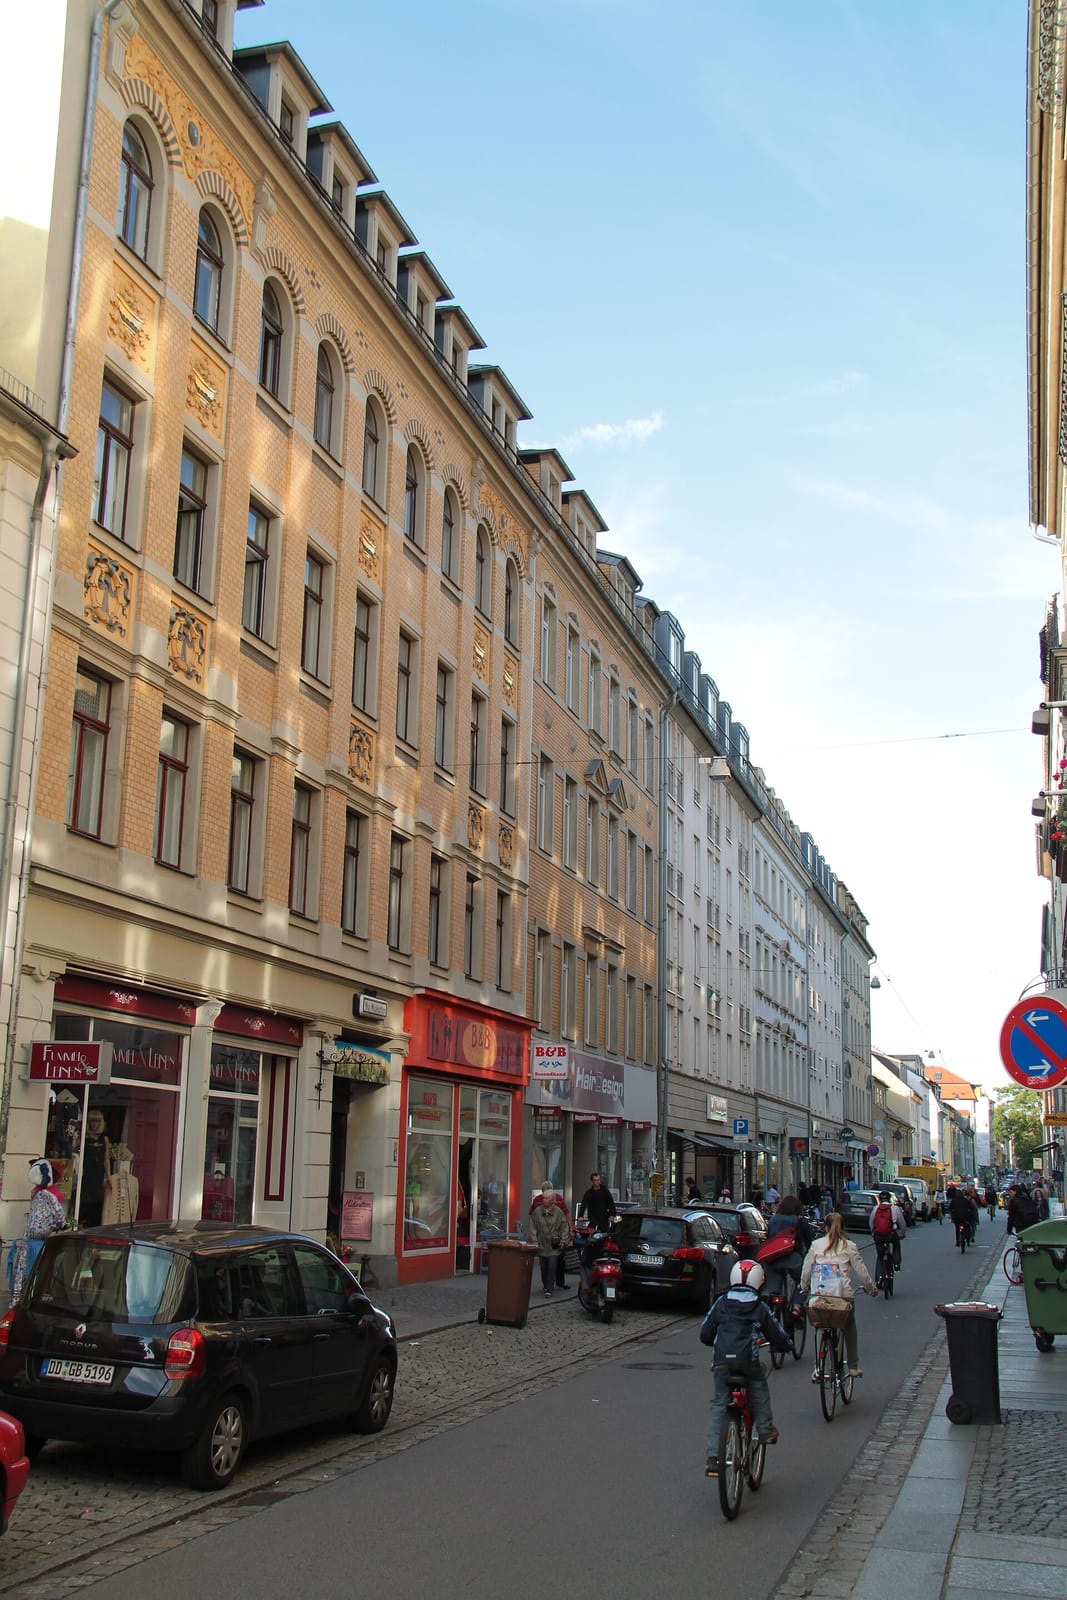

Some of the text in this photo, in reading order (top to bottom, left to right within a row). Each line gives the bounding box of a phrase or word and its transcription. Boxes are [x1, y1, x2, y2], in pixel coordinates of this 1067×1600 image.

[471, 1023, 491, 1050] B&B
[535, 1046, 567, 1057] B&B
[736, 1120, 746, 1133] P
[47, 1360, 63, 1375] DD
[68, 1362, 83, 1377] GB
[84, 1364, 112, 1381] 5196
